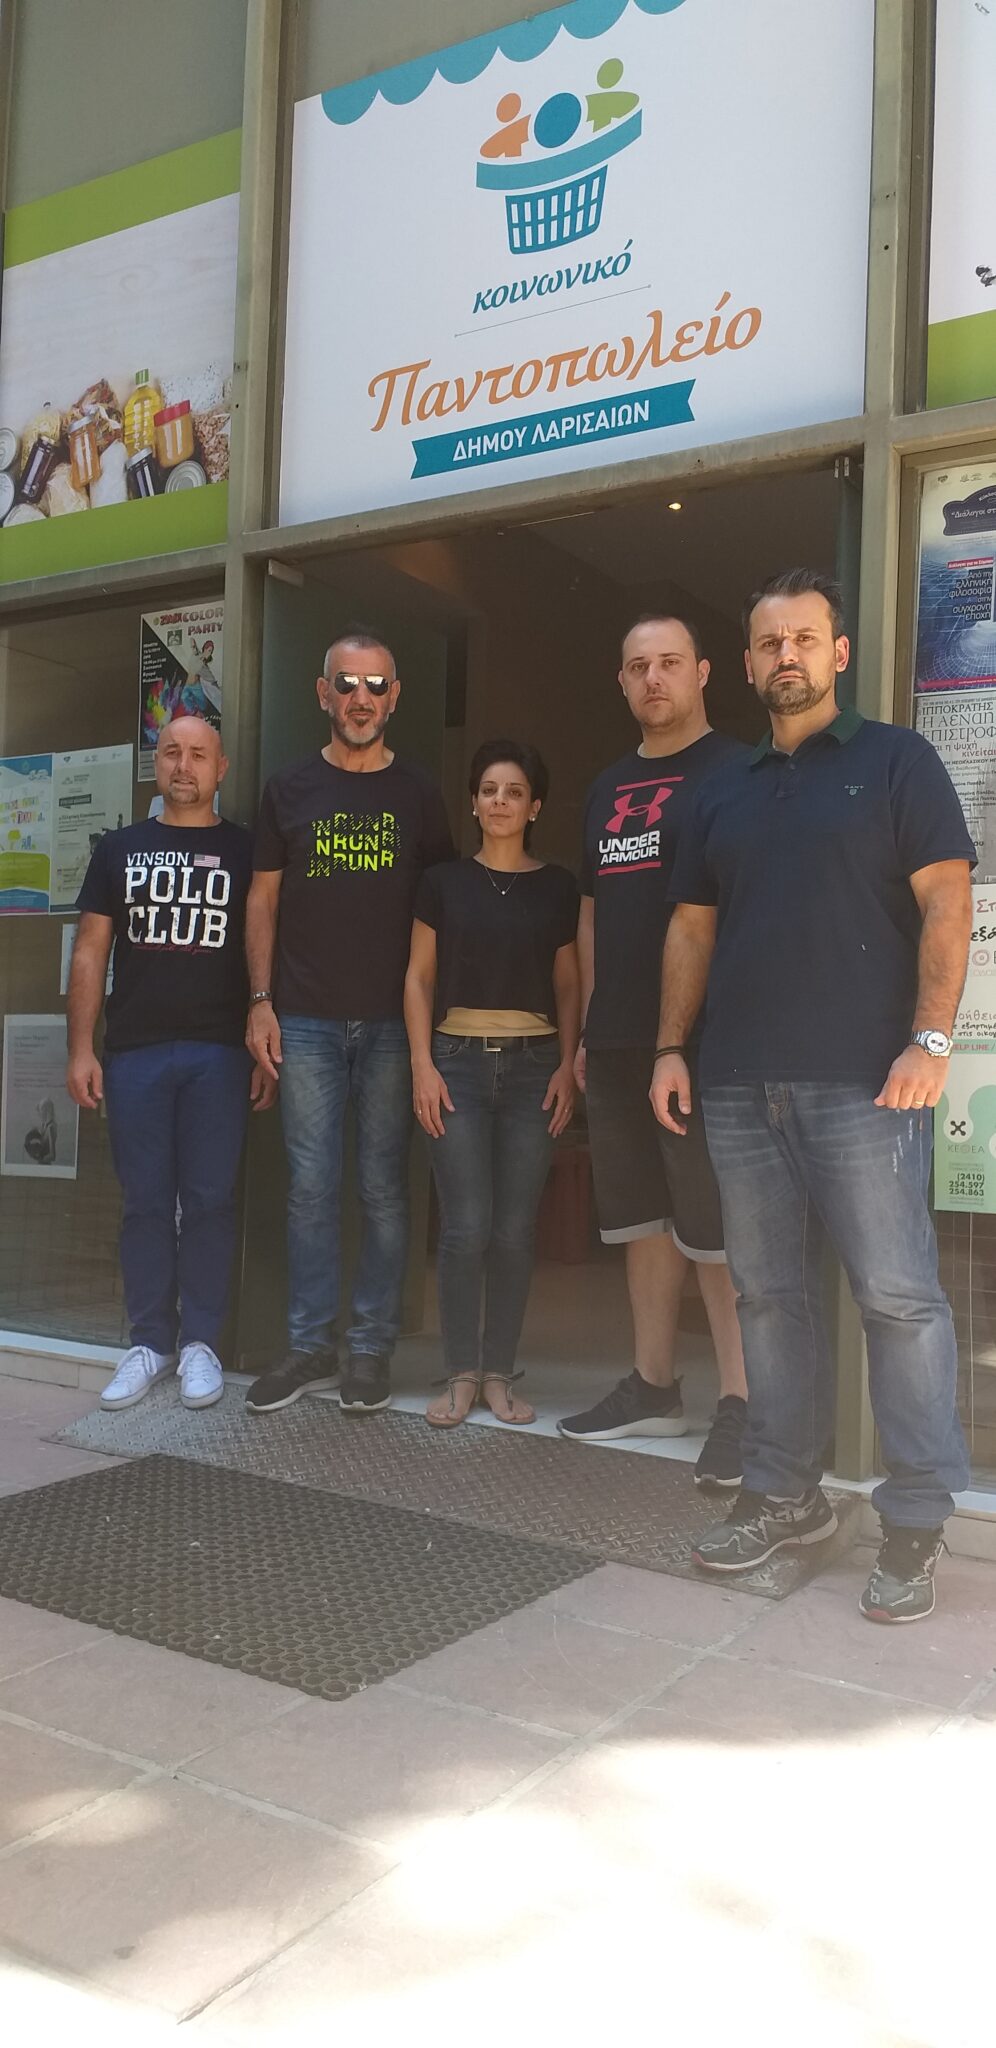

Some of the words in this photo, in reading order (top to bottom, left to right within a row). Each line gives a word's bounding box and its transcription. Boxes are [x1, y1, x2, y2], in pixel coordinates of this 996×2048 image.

[472, 239, 633, 314] κοινωνικό
[367, 291, 762, 432] Παντοπωλείο
[452, 425, 528, 463] ΔΗΜΟΥ
[531, 400, 650, 446] ΛΑΡΙΣΑΙΩΝ
[183, 607, 224, 622] COLOR
[188, 623, 223, 636] PARTY
[922, 702, 994, 716] ΙΠΠΟΚΡΑΤΗΣ
[953, 740, 978, 751] ψυχή
[962, 747, 996, 758] κινείται
[598, 830, 661, 854] UNDER
[126, 851, 190, 867] VINSON
[600, 845, 660, 865] ARMOUR
[124, 866, 231, 907] POLO
[976, 898, 996, 913] Στ
[127, 905, 228, 948] CLUB
[970, 926, 996, 942] εξά
[958, 1009, 996, 1021] οήθει
[961, 1021, 996, 1030] εξαρτημέ
[976, 1030, 996, 1038] οικογ
[971, 1043, 990, 1051] LINE
[948, 1180, 985, 1189] 254.597
[957, 1172, 985, 1182] (2410)
